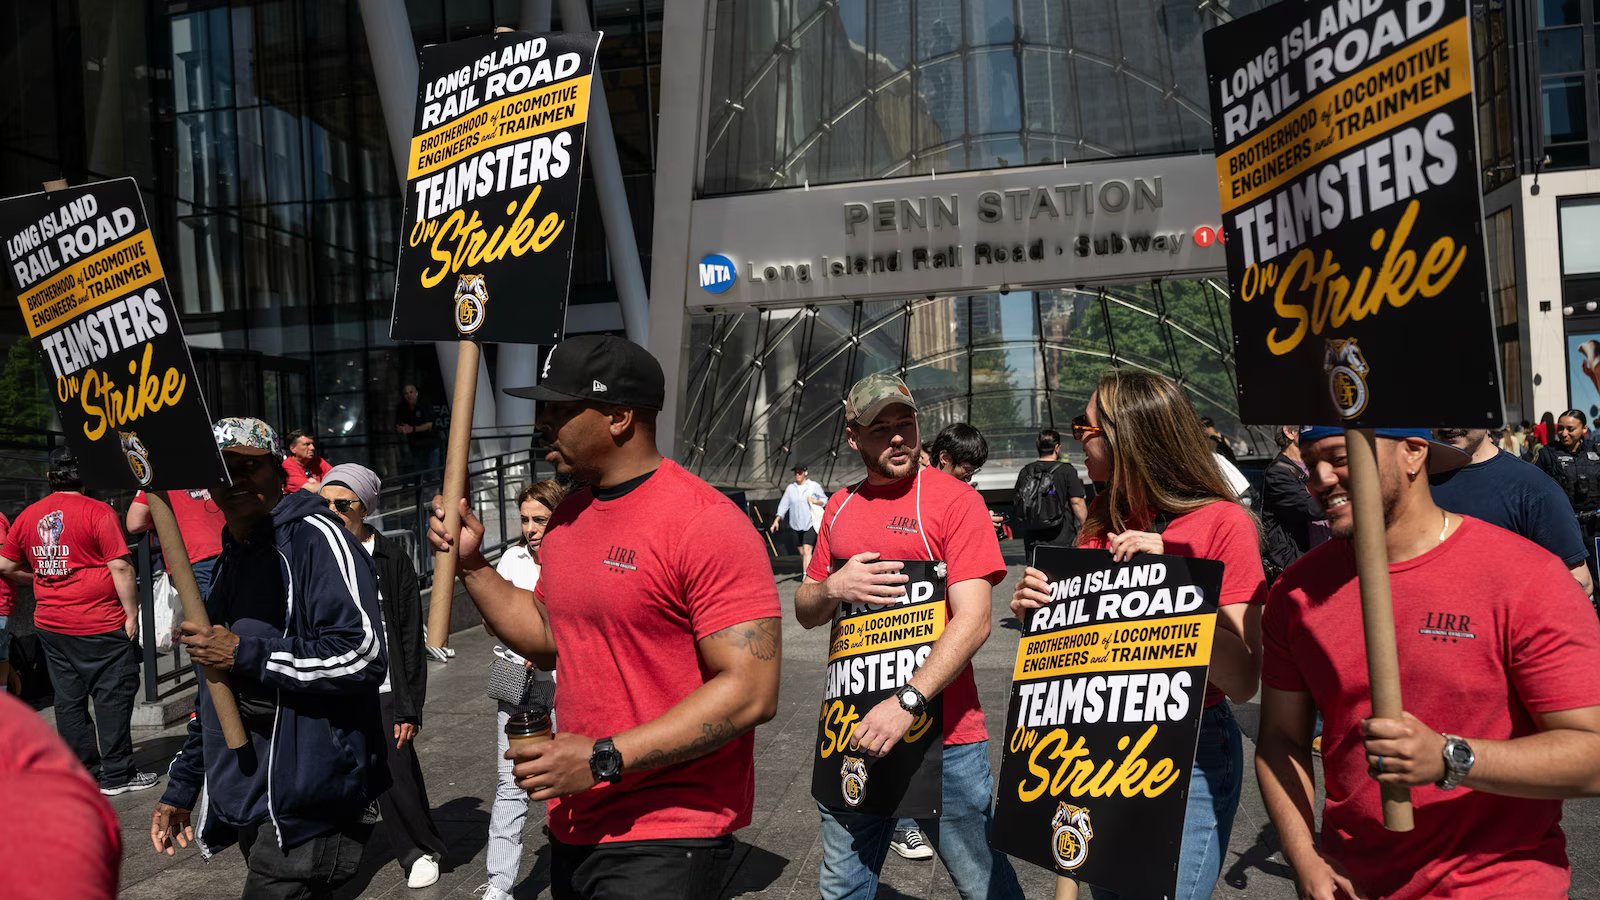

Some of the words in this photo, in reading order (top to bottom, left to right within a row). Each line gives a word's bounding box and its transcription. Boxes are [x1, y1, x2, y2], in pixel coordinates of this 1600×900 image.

[422, 84, 479, 130] RAIL
[485, 52, 581, 101] ROAD
[424, 66, 471, 103] LONG
[473, 37, 547, 81] ISLAND
[1220, 46, 1278, 108] LONG
[1224, 72, 1300, 145] RAIL
[1304, 0, 1445, 94] ROAD
[418, 132, 480, 170] ENGINEERS
[481, 127, 497, 143] and
[499, 103, 576, 136] TRAINMEN
[420, 111, 488, 153] BROTHERHOOD
[490, 109, 500, 126] of
[500, 85, 578, 119] LOCOMOTIVE
[1229, 108, 1317, 176] BROTHERHOOD
[1321, 101, 1333, 129] of
[1334, 38, 1449, 113] LOCOMOTIVE
[1231, 138, 1312, 199] ENGINEERS
[1314, 127, 1336, 153] and
[1336, 68, 1450, 140] TRAINMEN
[415, 131, 572, 222] TEAMSTERS
[843, 194, 958, 235] PENN
[977, 176, 1163, 223] STATION
[1234, 112, 1458, 268] TEAMSTERS
[7, 226, 42, 261] LONG
[40, 194, 98, 239] ISLAND
[14, 248, 60, 288] RAIL
[58, 206, 136, 264] ROAD
[410, 218, 439, 247] On
[421, 184, 565, 288] Strike
[748, 261, 812, 283] Long
[822, 251, 900, 277] Island
[912, 244, 962, 271] Rail
[974, 238, 1044, 265] Road
[1074, 231, 1185, 256] Subway
[26, 274, 76, 312] BROTHERHOOD
[77, 272, 86, 289] of
[82, 240, 147, 282] LOCOMOTIVE
[32, 294, 78, 329] ENGINEERS
[78, 289, 90, 304] and
[88, 259, 152, 299] TRAINMEN
[699, 262, 732, 288] MTA
[1241, 262, 1278, 302] On
[1267, 199, 1467, 355] Strike
[41, 287, 168, 378] TEAMSTERS
[57, 374, 79, 402] On
[81, 342, 186, 441] Strike
[607, 545, 636, 564] LIRR
[891, 515, 917, 530] LIRR
[1030, 599, 1090, 633] RAIL
[1096, 585, 1204, 621] ROAD
[1049, 575, 1082, 603] ONG
[1083, 563, 1167, 595] ISLAND
[850, 637, 864, 649] and
[865, 623, 934, 646] TRAINMEN
[856, 623, 865, 637] of
[865, 608, 935, 631] LOCOMOTIVE
[1026, 631, 1099, 656] BROTHERHOOD
[1101, 632, 1112, 650] of
[1113, 623, 1201, 644] LOCOMOTIVE
[1425, 612, 1471, 632] LIRR
[1023, 651, 1088, 673] ENGINEERS
[1090, 650, 1109, 664] and
[1111, 642, 1198, 663] TRAINMEN
[1017, 671, 1192, 728] TEAMSTERS
[1010, 724, 1039, 753] On
[1018, 724, 1180, 802] Strike
